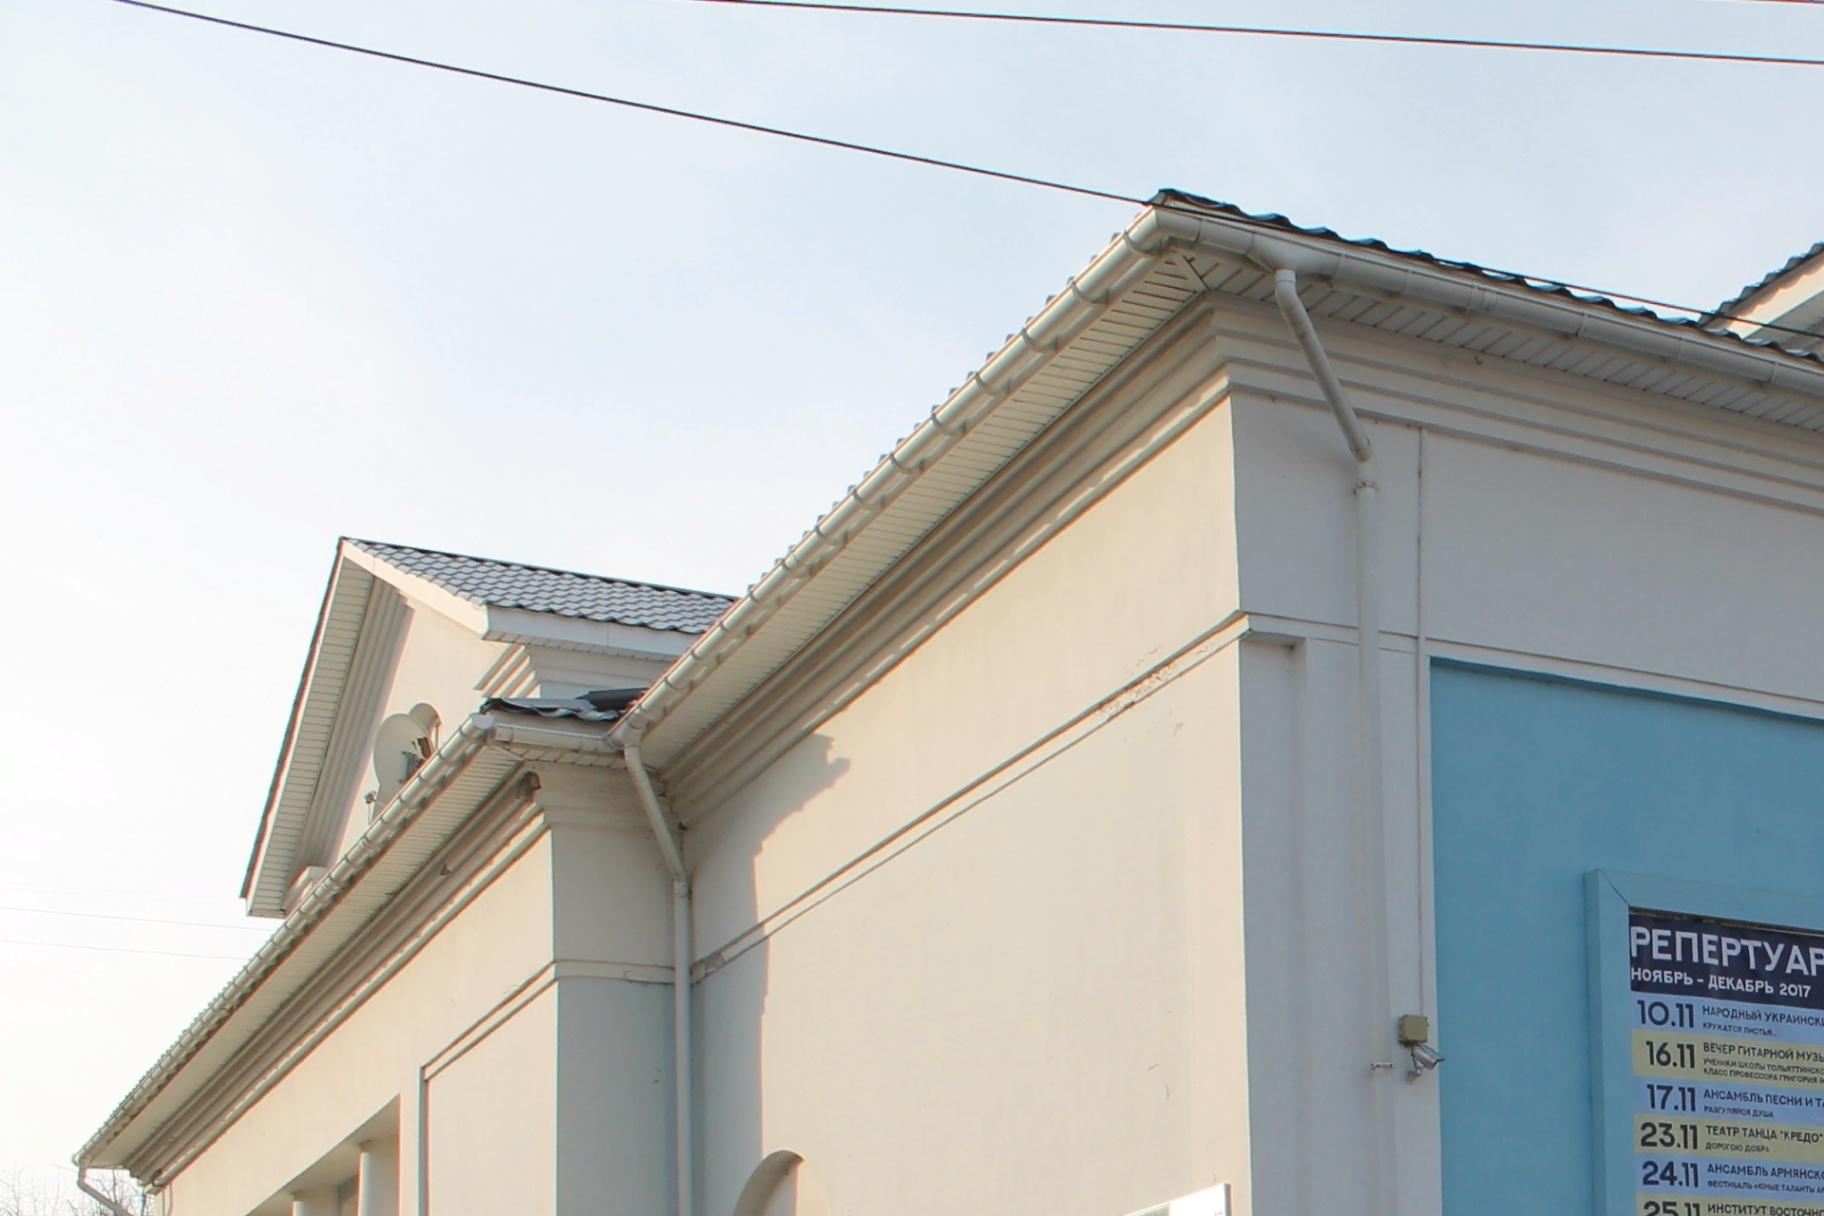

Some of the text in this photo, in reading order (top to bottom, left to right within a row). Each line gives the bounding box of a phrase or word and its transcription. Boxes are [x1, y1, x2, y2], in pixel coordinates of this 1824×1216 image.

[1631, 967, 1693, 986] НОЯБРЬ
[1708, 975, 1774, 994] ДЕКАБРЬ
[1779, 983, 1811, 998] 2017
[1637, 1000, 1695, 1028] 10.11
[1702, 1006, 1761, 1021] НАРОДНЫЙ
[1646, 1041, 1695, 1068] 16.11
[1703, 1042, 1735, 1055] ВЕЧЕР
[1738, 1045, 1793, 1060] ГИТАРНОЙ
[1646, 1084, 1696, 1112] 17.11
[1703, 1089, 1764, 1104] АНСАМБЛЬ
[1766, 1094, 1802, 1106] ПЕСНИ
[1805, 1098, 1813, 1107] И
[1640, 1122, 1698, 1149] 23.11
[1705, 1125, 1739, 1136] ТЕАТР
[1743, 1127, 1777, 1140] ТАНЦА
[1705, 1142, 1742, 1151] ДОРОГОЮ
[1642, 1161, 1699, 1188] 24.11
[1707, 1163, 1768, 1177] АНСАМБЛЬ
[1708, 1203, 1766, 1216] ИНСТИТУТ
